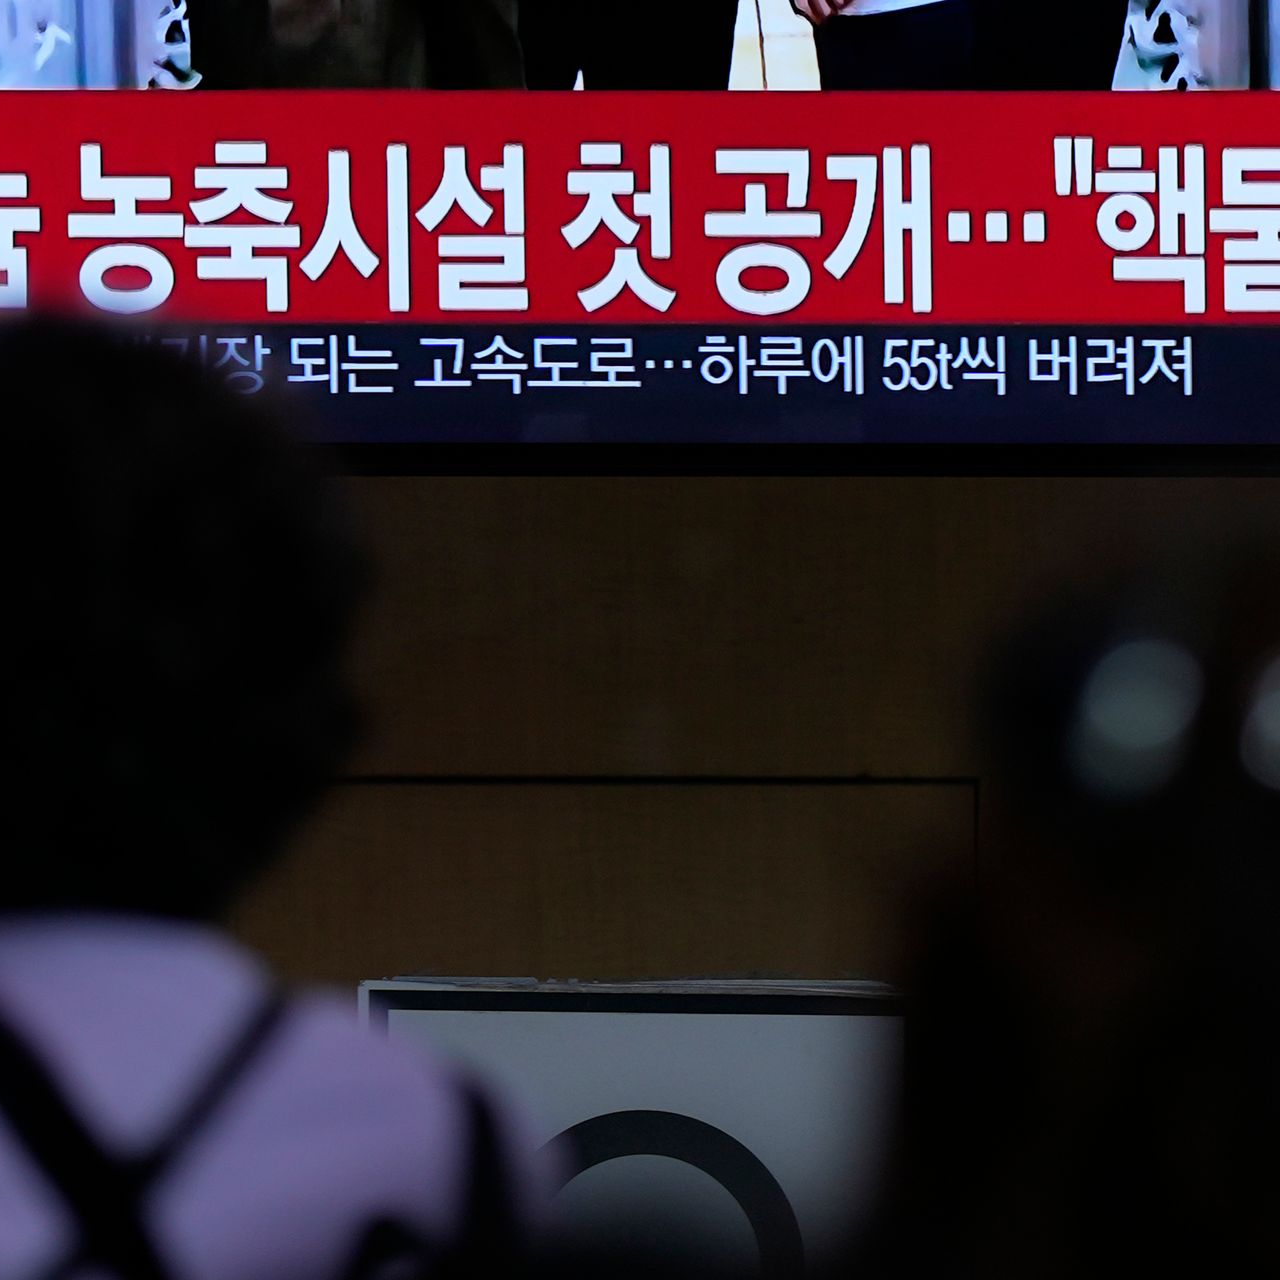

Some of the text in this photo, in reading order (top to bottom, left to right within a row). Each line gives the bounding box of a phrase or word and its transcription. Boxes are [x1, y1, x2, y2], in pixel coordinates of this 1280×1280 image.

[67, 142, 531, 316] 농축시설
[561, 144, 677, 314] 첫
[288, 335, 400, 395] 되는
[883, 336, 1007, 397] 55t씩
[1029, 336, 1195, 397] 버려져
